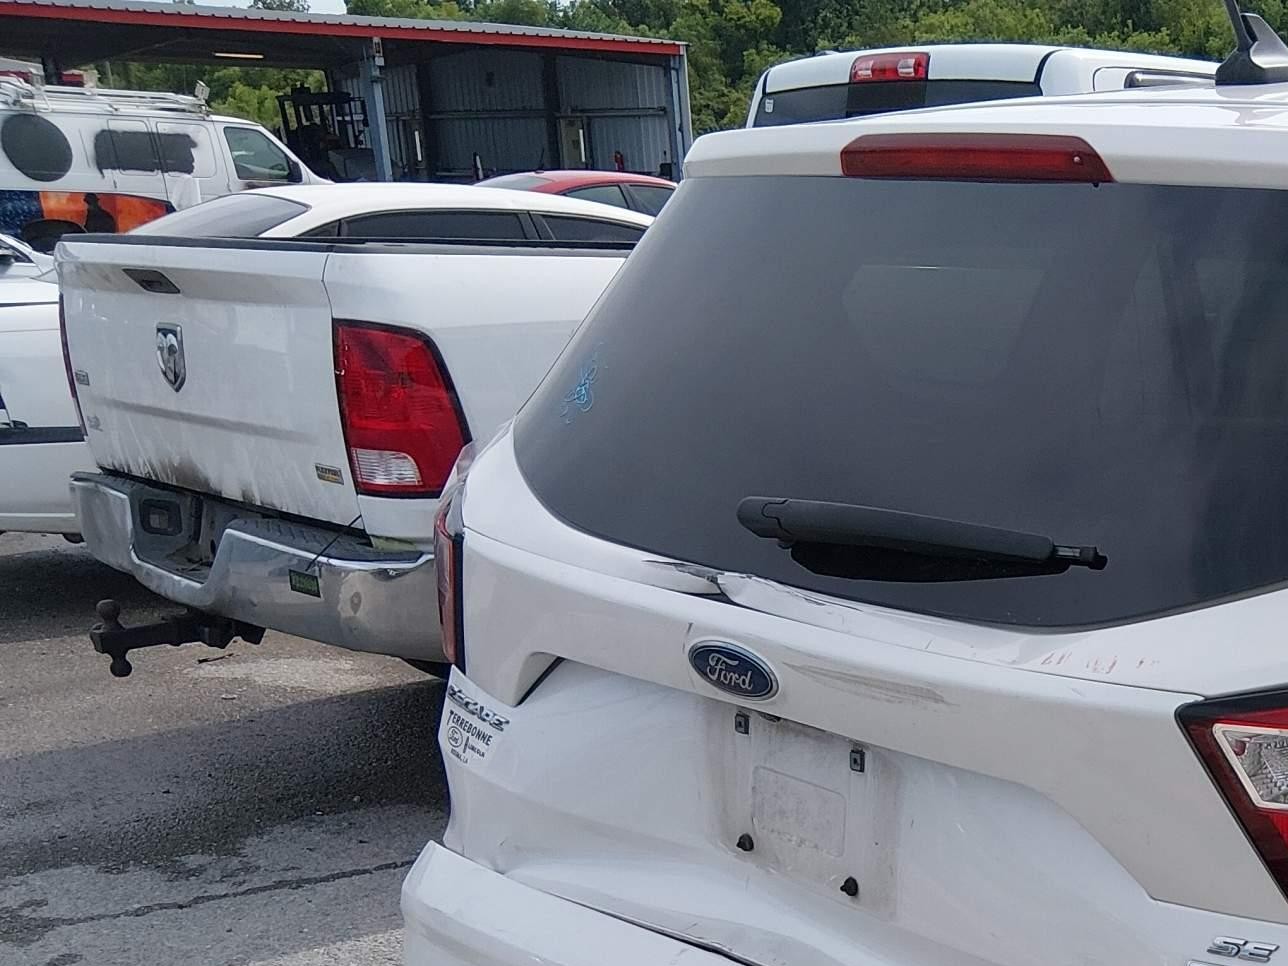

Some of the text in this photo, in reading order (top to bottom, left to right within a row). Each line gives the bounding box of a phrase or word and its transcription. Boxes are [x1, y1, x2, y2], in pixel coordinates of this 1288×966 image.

[706, 653, 754, 690] Ford
[446, 709, 494, 746] TERREBONNE
[1206, 935, 1281, 963] SE
